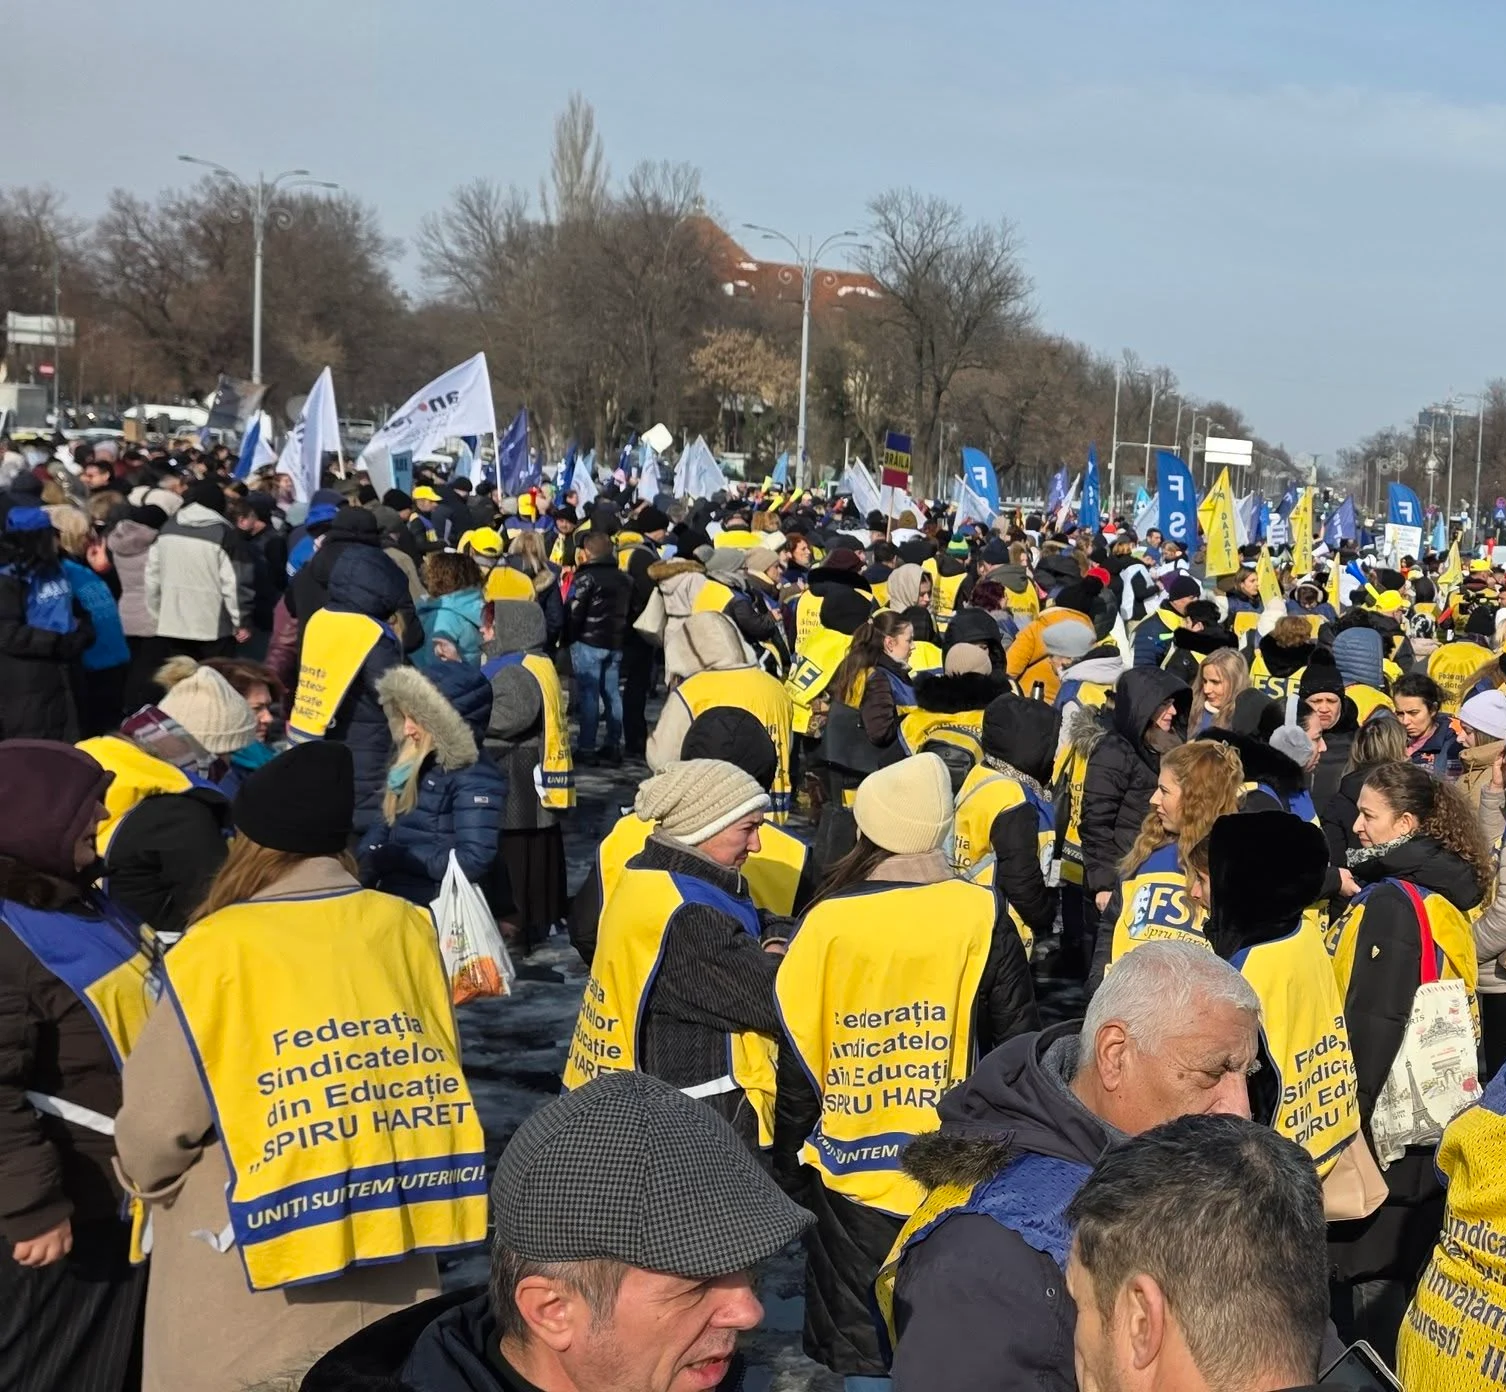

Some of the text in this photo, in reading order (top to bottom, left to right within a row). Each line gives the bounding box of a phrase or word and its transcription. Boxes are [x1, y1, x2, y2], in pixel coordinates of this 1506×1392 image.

[272, 1011, 424, 1056] Federația
[830, 1030, 952, 1060] indicatelo
[257, 1042, 446, 1096] Sindicatelor
[827, 1059, 949, 1087] din Educați
[267, 1073, 459, 1128] din Educație
[1285, 1103, 1312, 1129] din
[249, 1102, 471, 1175] „SPIRU HARET
[1288, 1108, 1339, 1144] PIRU
[247, 1196, 308, 1229] UNIȚI
[1408, 1308, 1464, 1358] urești
